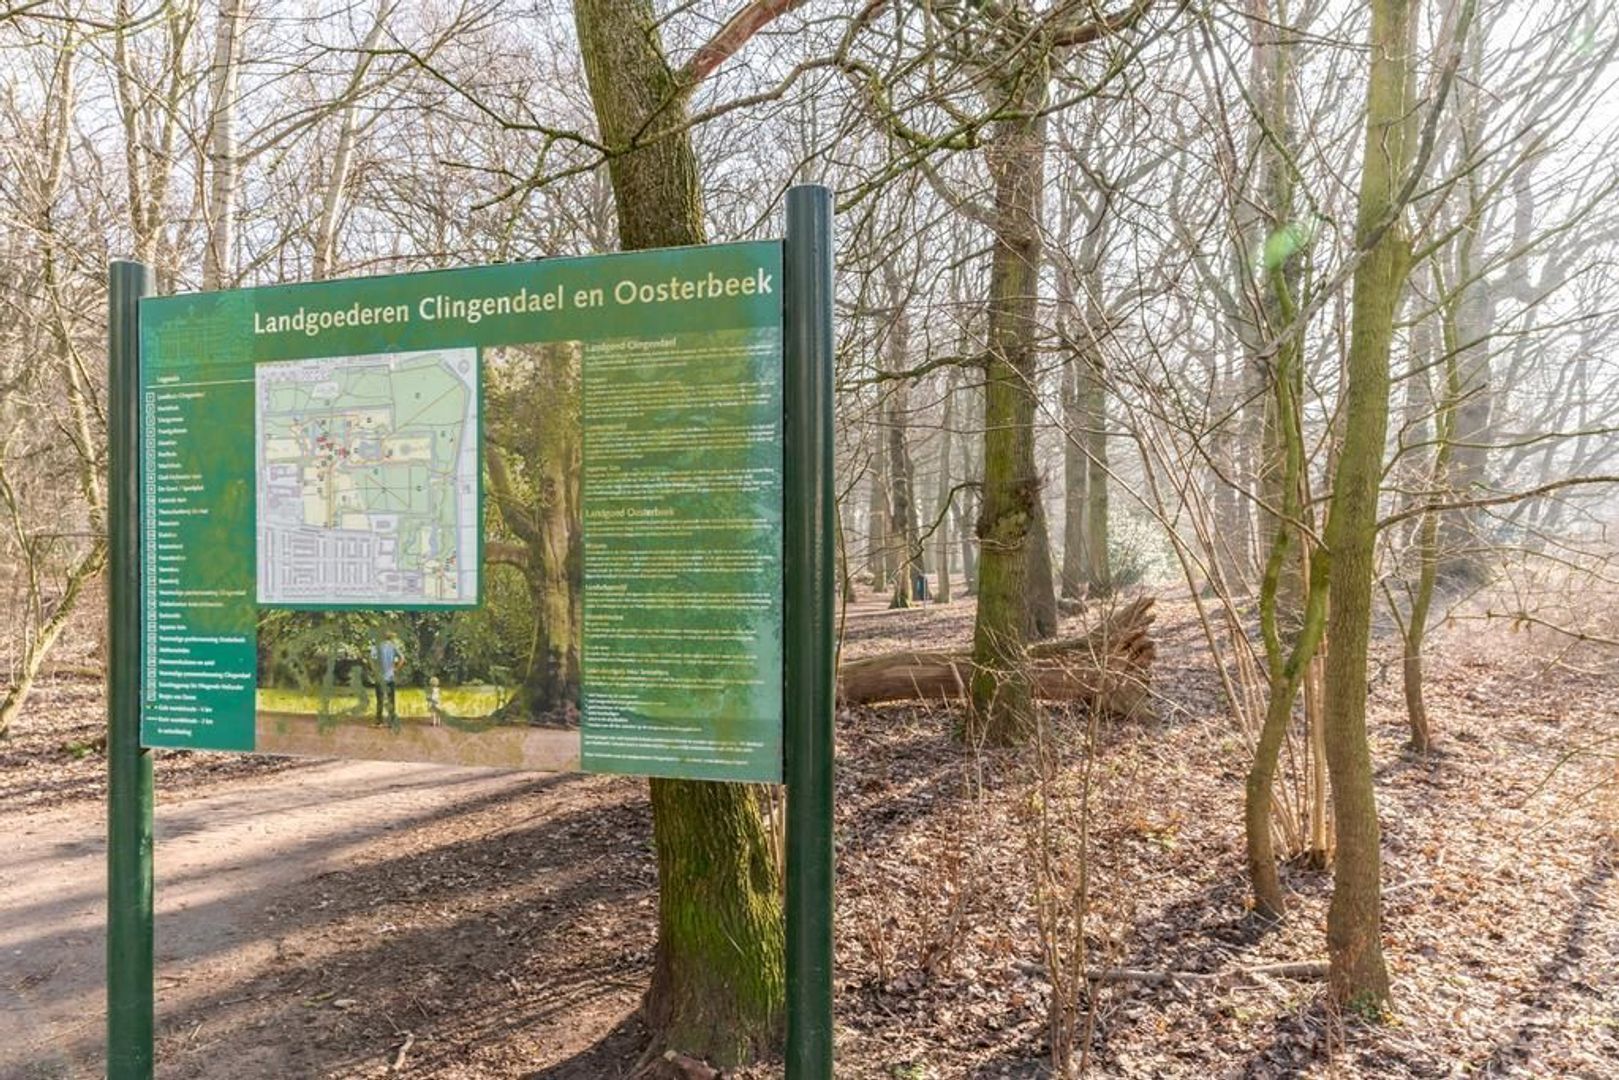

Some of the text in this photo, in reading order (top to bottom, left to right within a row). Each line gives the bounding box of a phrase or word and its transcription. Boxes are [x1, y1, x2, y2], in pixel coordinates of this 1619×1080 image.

[254, 268, 773, 336] Landgoederen Clingendael en Oosterbeek
[585, 342, 625, 353] Landgoed
[585, 508, 625, 519] Landgoed
